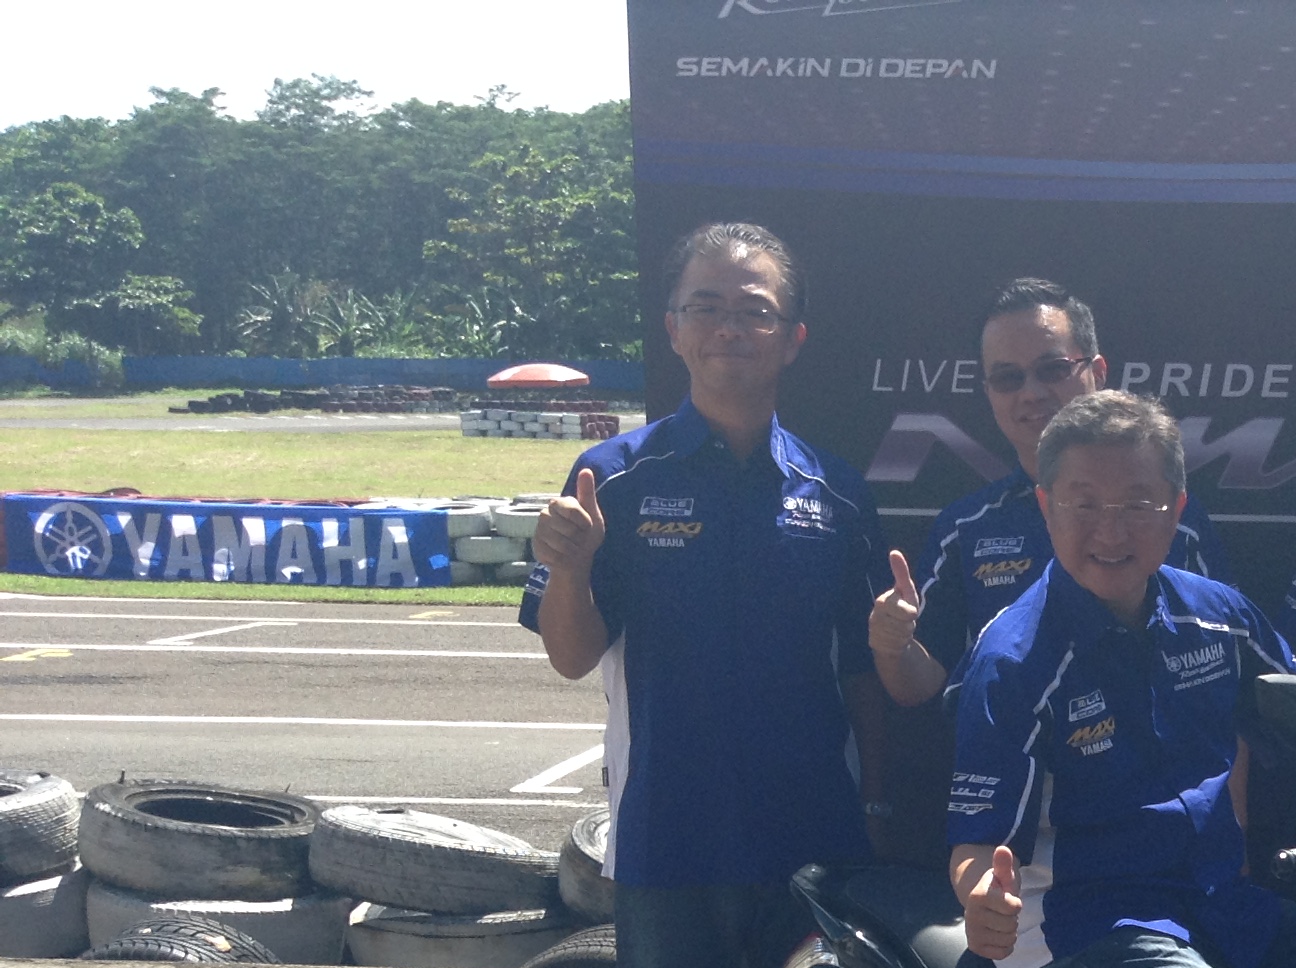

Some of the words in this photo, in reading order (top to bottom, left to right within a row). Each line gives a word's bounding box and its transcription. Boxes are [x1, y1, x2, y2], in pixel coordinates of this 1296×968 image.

[878, 57, 999, 80] DEPAN
[871, 357, 979, 395] LIVE
[1119, 361, 1294, 399] PRIDE
[636, 520, 703, 536] MAXI
[116, 512, 420, 588] YAMAHA
[647, 537, 686, 548] YAMAHA
[983, 574, 1017, 588] YAMAHA
[1179, 641, 1227, 670] YAMAHA
